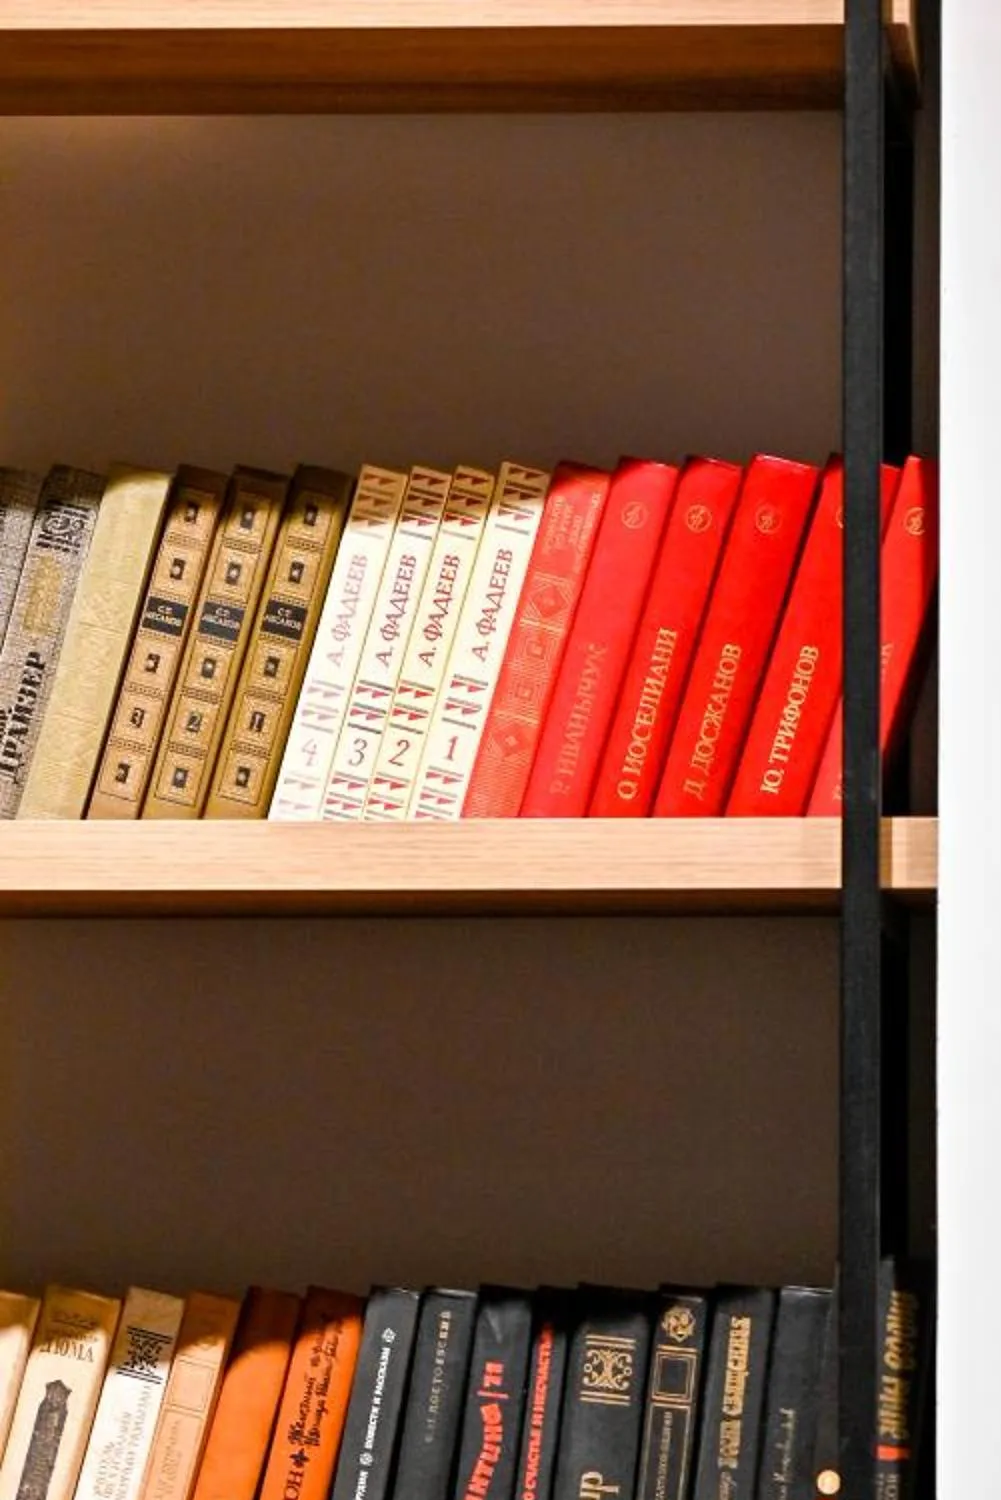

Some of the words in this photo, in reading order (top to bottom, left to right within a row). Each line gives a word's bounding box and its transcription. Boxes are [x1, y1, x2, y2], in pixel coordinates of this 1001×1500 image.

[380, 553, 417, 642] ФАДЕЕВ
[423, 553, 461, 642] ФАДЕЕВ
[475, 547, 513, 635] ФАДЕЕВ
[445, 734, 459, 763] 1
[690, 642, 742, 776] ДОСЖАНОВ
[769, 644, 820, 765] ТРИФОНОВ
[299, 738, 320, 767] 4
[348, 737, 368, 767] 3
[387, 738, 411, 767] 2
